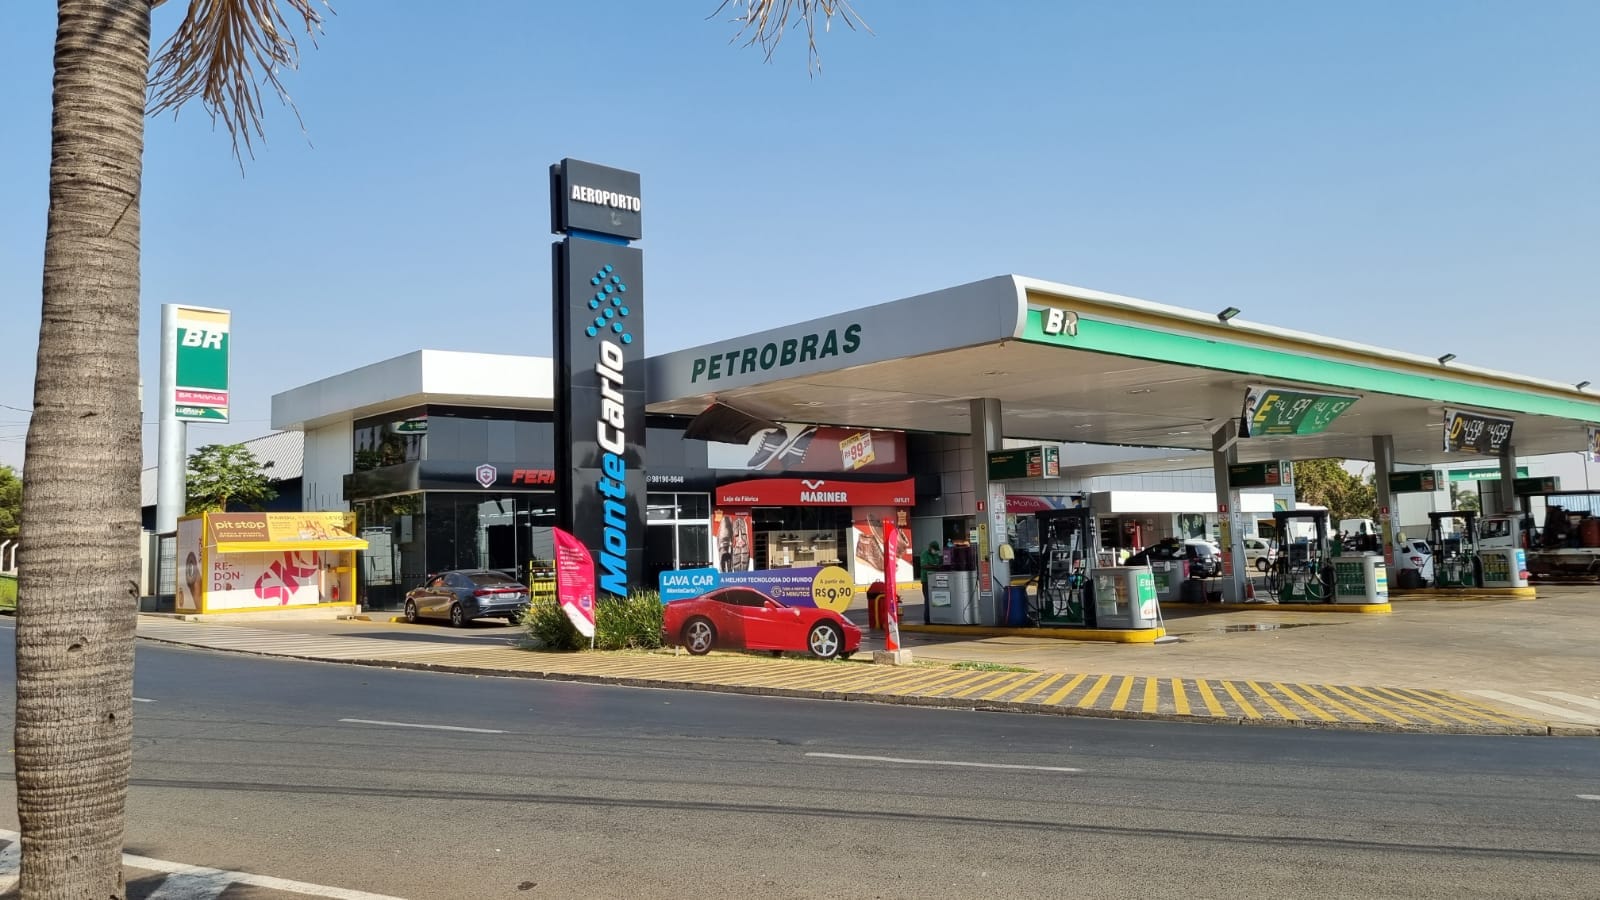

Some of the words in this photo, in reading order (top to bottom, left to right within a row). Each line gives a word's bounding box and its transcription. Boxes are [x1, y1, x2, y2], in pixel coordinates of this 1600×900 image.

[571, 184, 641, 212] AEROPORTO
[1041, 308, 1079, 336] BR
[181, 328, 223, 349] BR
[691, 324, 862, 384] PETROBRAS
[595, 339, 628, 598] MonteCarlo
[800, 491, 847, 502] MARINER
[215, 520, 234, 530] pit
[234, 520, 266, 530] stop
[214, 562, 233, 571] RE-
[214, 571, 244, 581] DON-
[663, 575, 690, 586] LAVA
[691, 575, 714, 586] CAR
